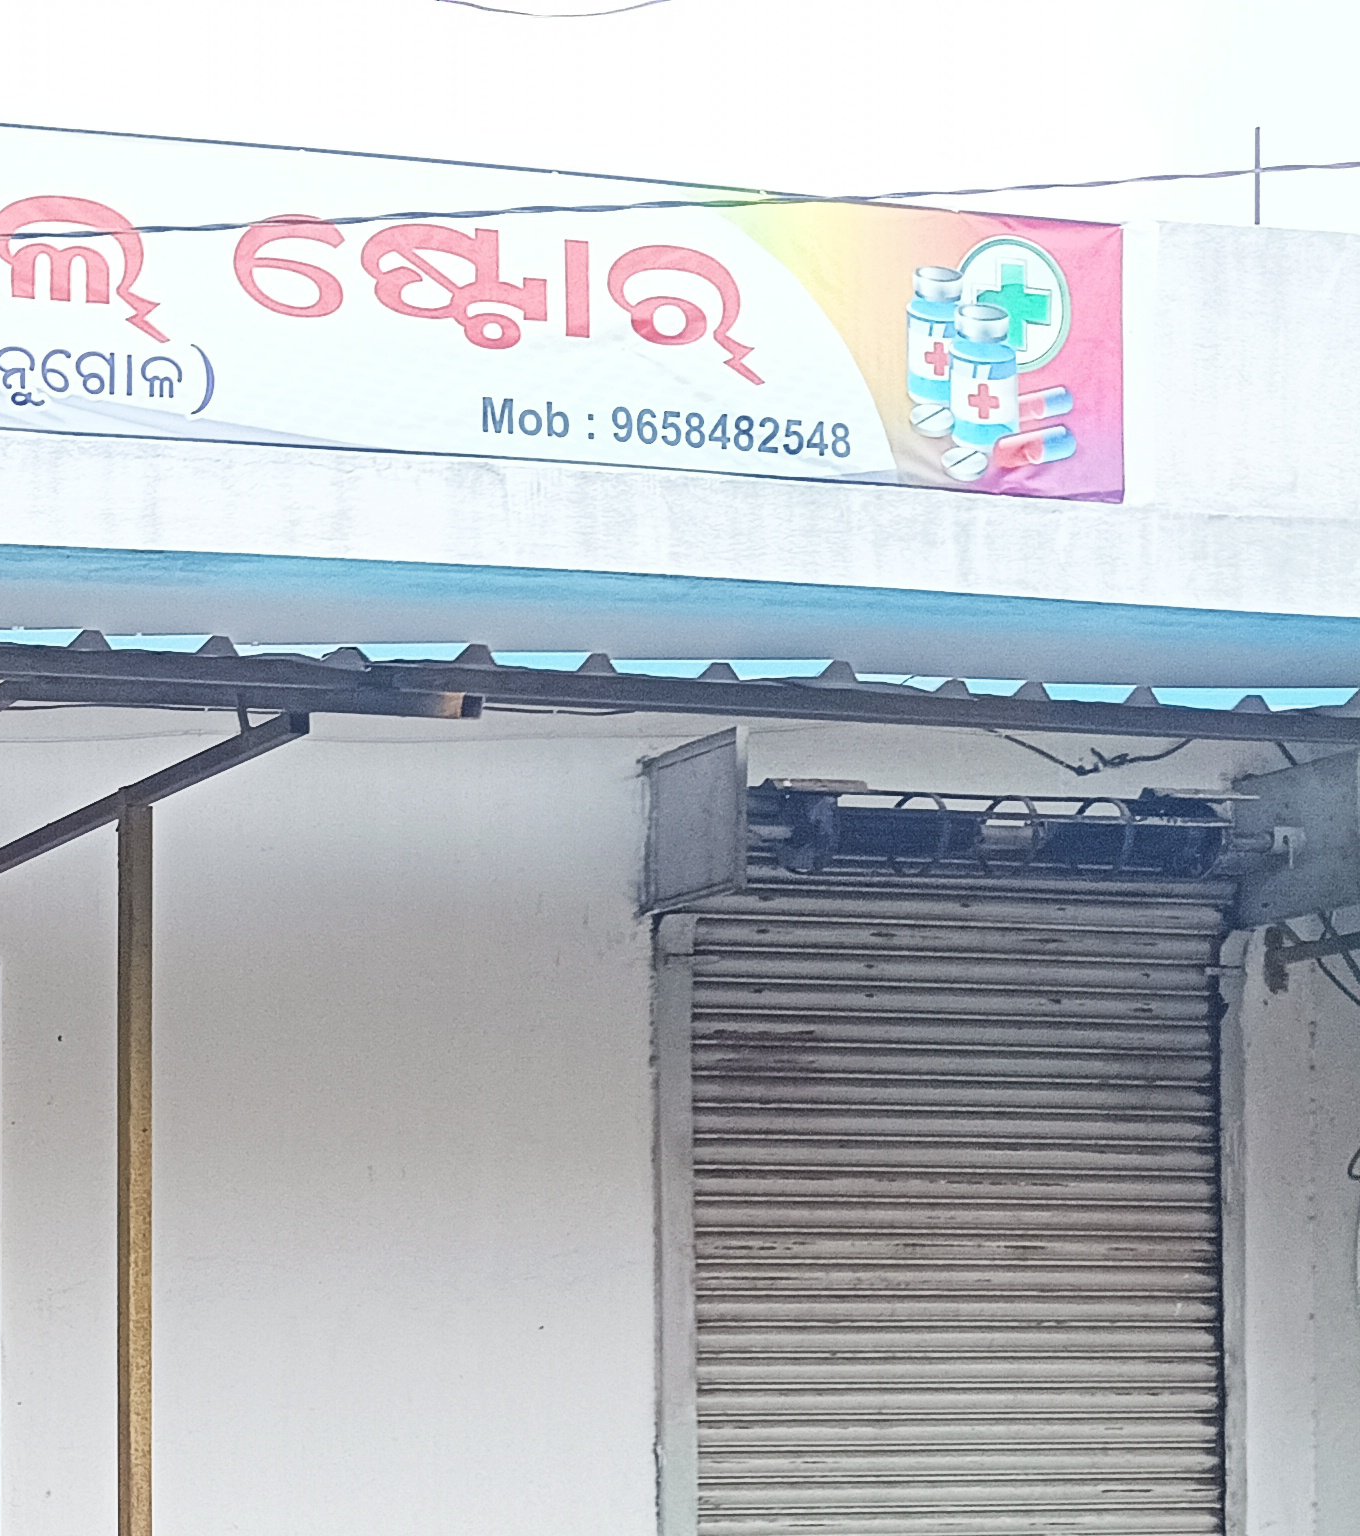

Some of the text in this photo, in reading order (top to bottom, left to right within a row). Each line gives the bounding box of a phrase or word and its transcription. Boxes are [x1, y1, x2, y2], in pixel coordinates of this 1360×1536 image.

[232, 213, 766, 386] ଷ୍ଟୋର୍
[482, 397, 571, 438] Mob
[611, 406, 853, 459] 9658482548
